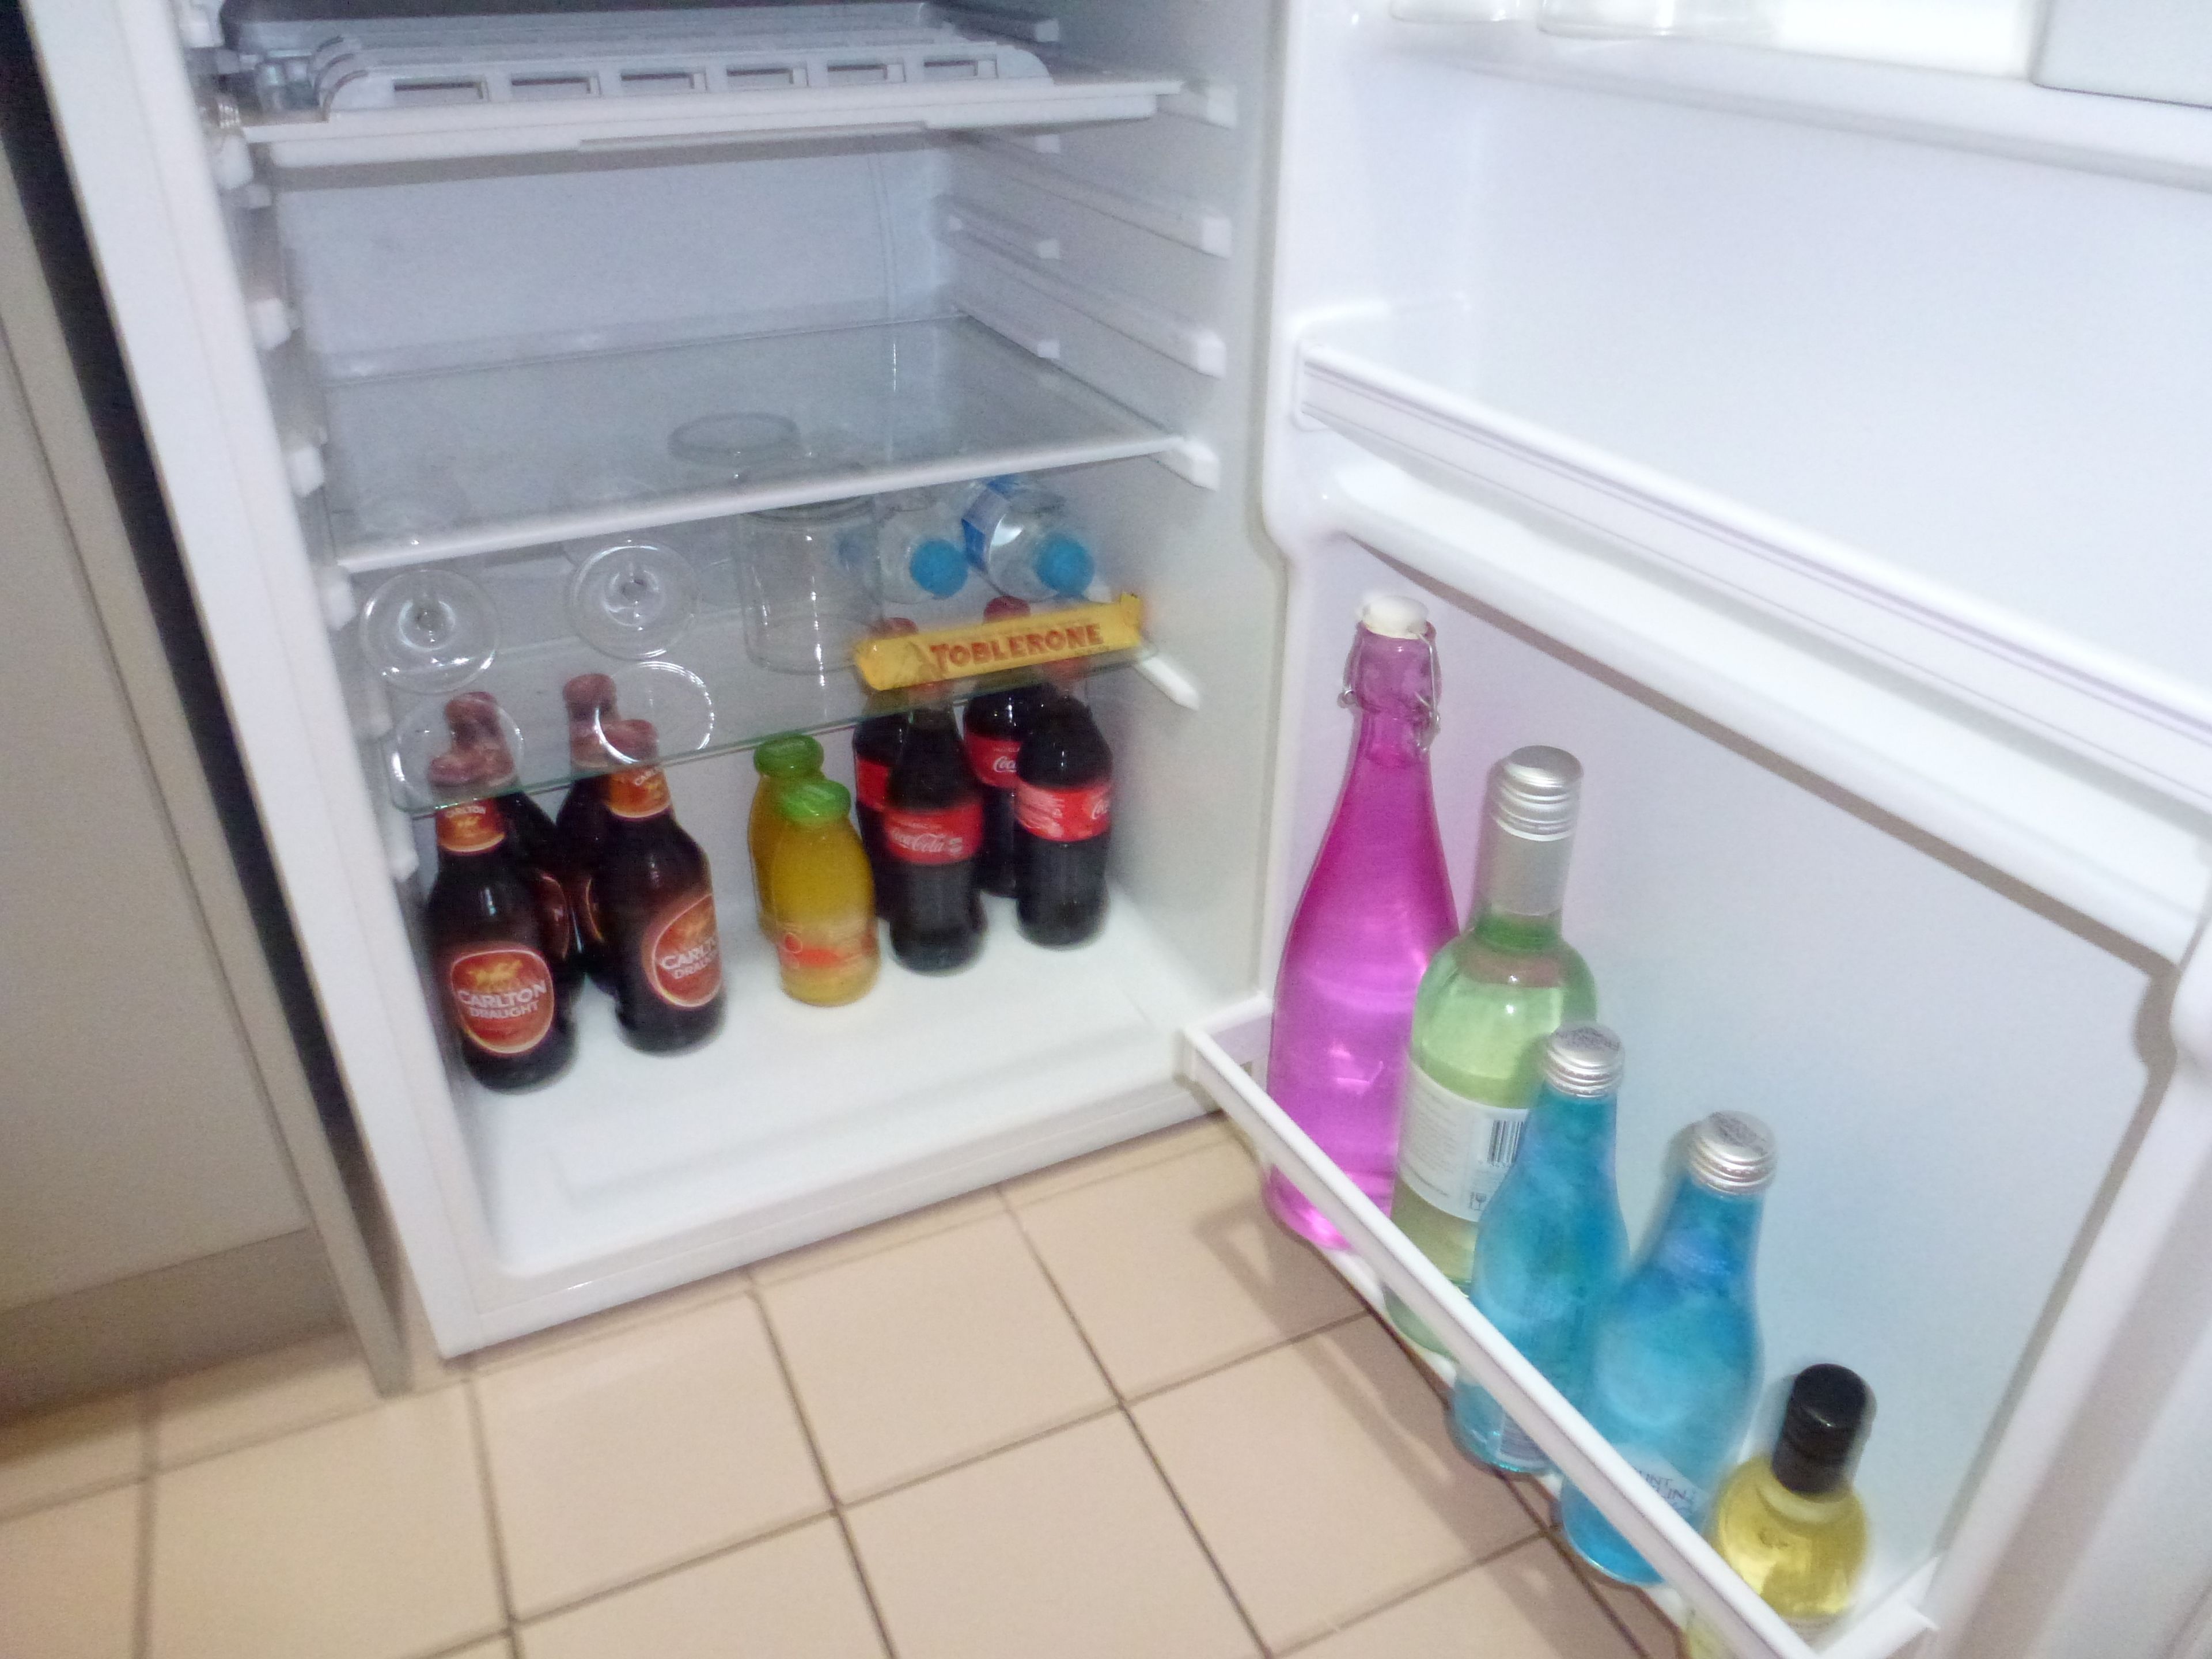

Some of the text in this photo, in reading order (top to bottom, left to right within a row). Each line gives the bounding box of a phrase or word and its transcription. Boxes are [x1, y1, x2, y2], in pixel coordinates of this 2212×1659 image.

[930, 623, 1104, 675] TOBLERONE
[457, 979, 547, 1009] CARLTON
[469, 999, 540, 1019] DRAUGHT
